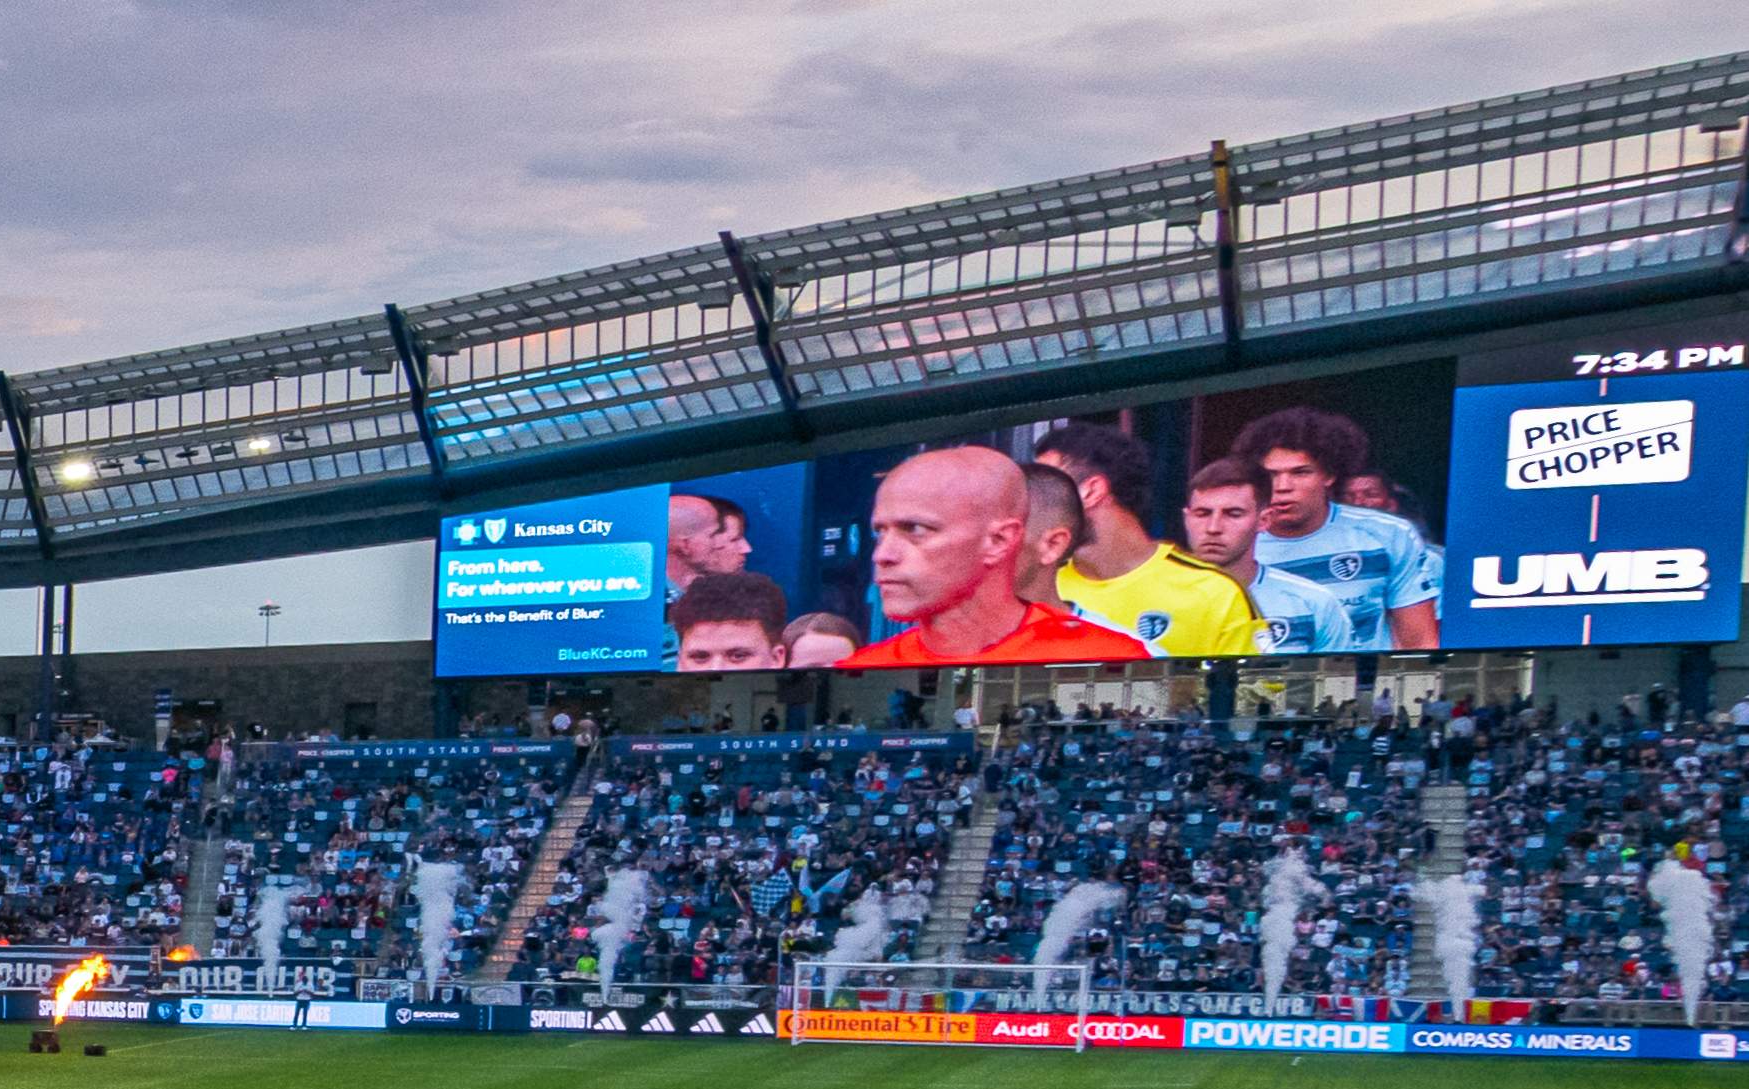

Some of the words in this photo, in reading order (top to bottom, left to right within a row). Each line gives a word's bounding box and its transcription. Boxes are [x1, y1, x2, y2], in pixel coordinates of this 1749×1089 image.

[1572, 349, 1668, 375] 7:34
[1676, 345, 1744, 367] PM
[1524, 409, 1622, 450] PRICE
[1518, 431, 1681, 483] CHOPPER
[514, 521, 575, 538] Kansas
[578, 519, 612, 536] City
[448, 560, 495, 576] From
[498, 558, 544, 573] here.
[1472, 549, 1708, 597] UMB
[446, 582, 476, 598] For
[479, 578, 564, 596] wherever
[568, 579, 602, 596] you
[605, 576, 641, 591] are.
[485, 612, 506, 623] the
[508, 609, 553, 622] Benefit
[556, 609, 569, 620] of
[558, 647, 648, 661] BlueKC.com
[363, 747, 416, 756] SOUTH
[428, 746, 480, 755] STAND
[720, 740, 778, 749] SOUTH
[790, 738, 849, 748] SAND
[179, 966, 243, 993] OUR
[87, 1001, 126, 1018] KANSAS
[127, 1002, 151, 1020] CITY
[413, 1011, 460, 1020] SPORTING
[530, 1010, 586, 1029] SPORTING
[783, 1013, 899, 1034] Continental
[923, 1015, 970, 1034] Tire
[992, 1022, 1049, 1037] Audi
[1190, 1022, 1391, 1049] POWERADE
[1413, 1030, 1513, 1049] COMPASS
[1526, 1033, 1632, 1052] MINERALS
